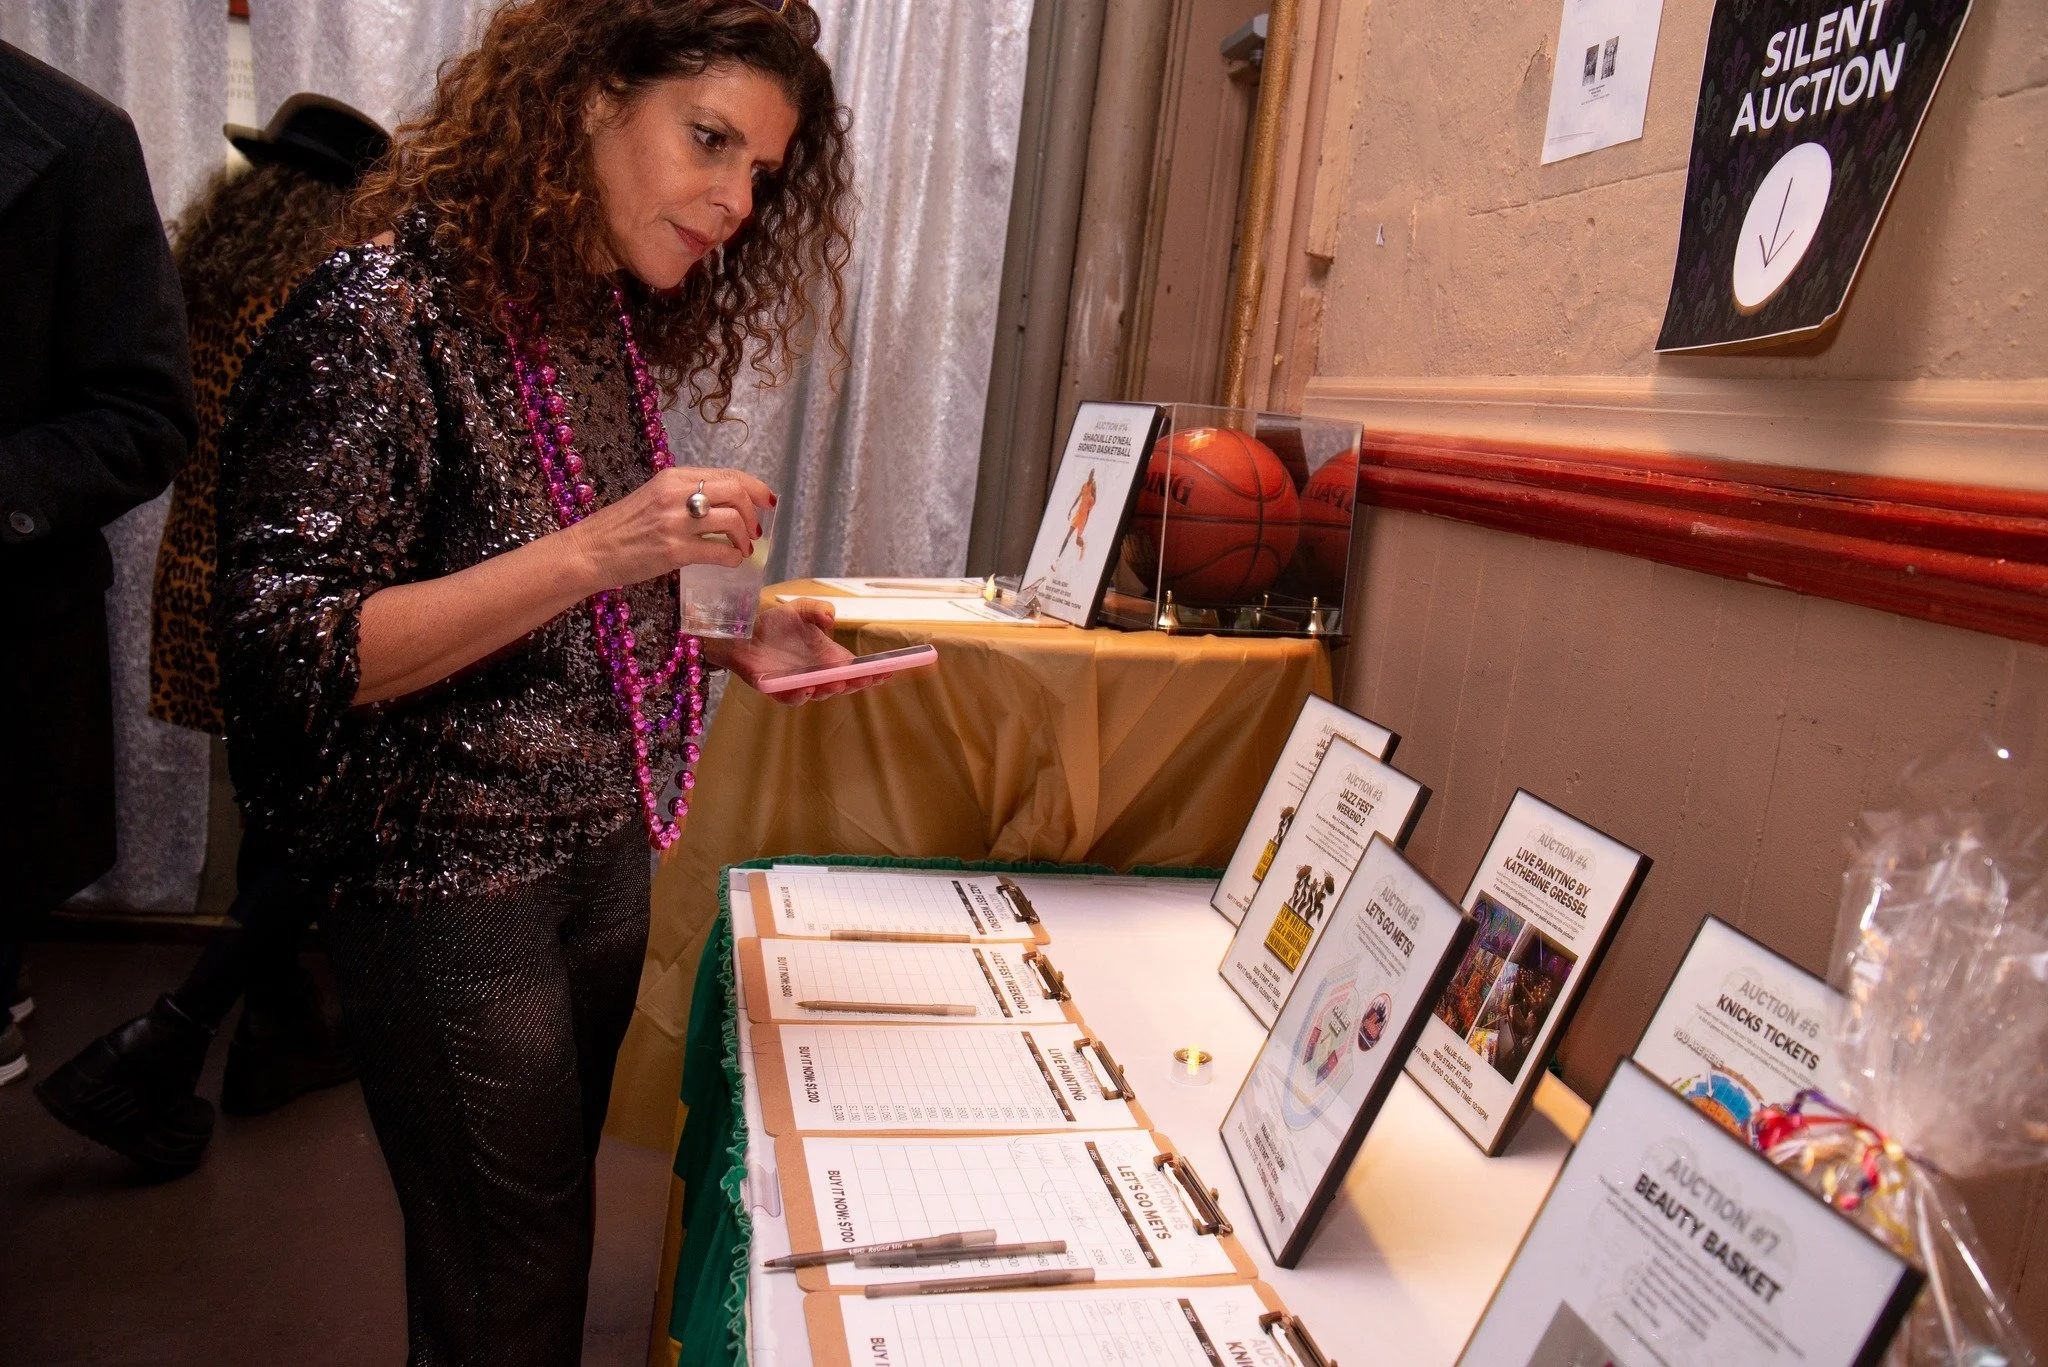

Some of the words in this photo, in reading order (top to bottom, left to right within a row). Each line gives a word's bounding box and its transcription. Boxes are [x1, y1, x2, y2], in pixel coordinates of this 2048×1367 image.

[1761, 0, 1886, 78] SILENT
[1730, 42, 1906, 138] AUCTION
[1082, 432, 1112, 443] SHAQUILLE
[1111, 435, 1133, 445] O'NEAL
[1096, 444, 1132, 457] BASKETBALL
[1343, 771, 1374, 796] AUCTION
[1370, 787, 1383, 802] #3
[1334, 800, 1363, 824] WEEKEND
[1359, 817, 1365, 827] 2
[1338, 786, 1358, 806] JAZZ
[1354, 797, 1374, 816] FEST
[1536, 832, 1577, 862] AUCTION
[1573, 853, 1590, 870] #4
[1515, 846, 1537, 866] LIVE
[1533, 857, 1578, 891] PAINTING
[1574, 882, 1591, 900] BY
[967, 883, 982, 894] JAZZ
[1502, 855, 1552, 893] KATHERINE
[1547, 884, 1591, 919] GRESSEL
[973, 895, 988, 905] FEST
[1378, 884, 1411, 922] AUCTION
[1406, 911, 1420, 932] #5
[979, 906, 1002, 928] WEEKEND
[1364, 897, 1386, 926] LET'S
[1380, 915, 1395, 937] GO
[1389, 926, 1415, 958] METS!
[776, 956, 787, 965] BUY
[989, 951, 1006, 964] JAZZ
[779, 972, 790, 984] NOW:
[996, 965, 1014, 979] FEST
[1003, 979, 1029, 1009] WEEKEND
[1737, 978, 1801, 1026] AUCTION
[1797, 1016, 1821, 1039] #6
[1714, 993, 1765, 1033] KNICKS
[1763, 1022, 1820, 1071] TICKETS
[798, 1046, 811, 1058] BUY
[1046, 1048, 1067, 1063] LIVE
[1432, 1048, 1443, 1061] BIDS
[1441, 1056, 1456, 1073] START
[1442, 1042, 1458, 1060] VALUE:
[802, 1066, 815, 1082] NOW:
[1055, 1065, 1088, 1100] PAINTING
[1442, 1073, 1462, 1095] CLOSING
[803, 1083, 820, 1102] $1,200
[827, 1170, 842, 1186] BUY
[1115, 1165, 1145, 1190] LET'S
[830, 1187, 845, 1195] IT
[1131, 1192, 1155, 1207] GO
[1140, 1172, 1181, 1212] AUCTION
[1167, 1216, 1191, 1230] #5
[832, 1197, 850, 1219] NOW:
[1087, 1149, 1099, 1160] FIRST
[1100, 1174, 1112, 1184] LAST
[1113, 1197, 1128, 1212] PHONE
[1127, 1223, 1141, 1236] EMAIL
[1143, 1251, 1154, 1259] BID
[1664, 1158, 1754, 1232] AUCTION
[1750, 1217, 1784, 1257] #7
[836, 1221, 855, 1242] $700
[1141, 1210, 1173, 1239] METS
[1634, 1173, 1704, 1239] BEAUTY
[1703, 1223, 1784, 1304] BASKET
[1180, 1308, 1198, 1321] FIRST
[1198, 1342, 1218, 1356] LAST
[869, 1337, 887, 1360] BUY
